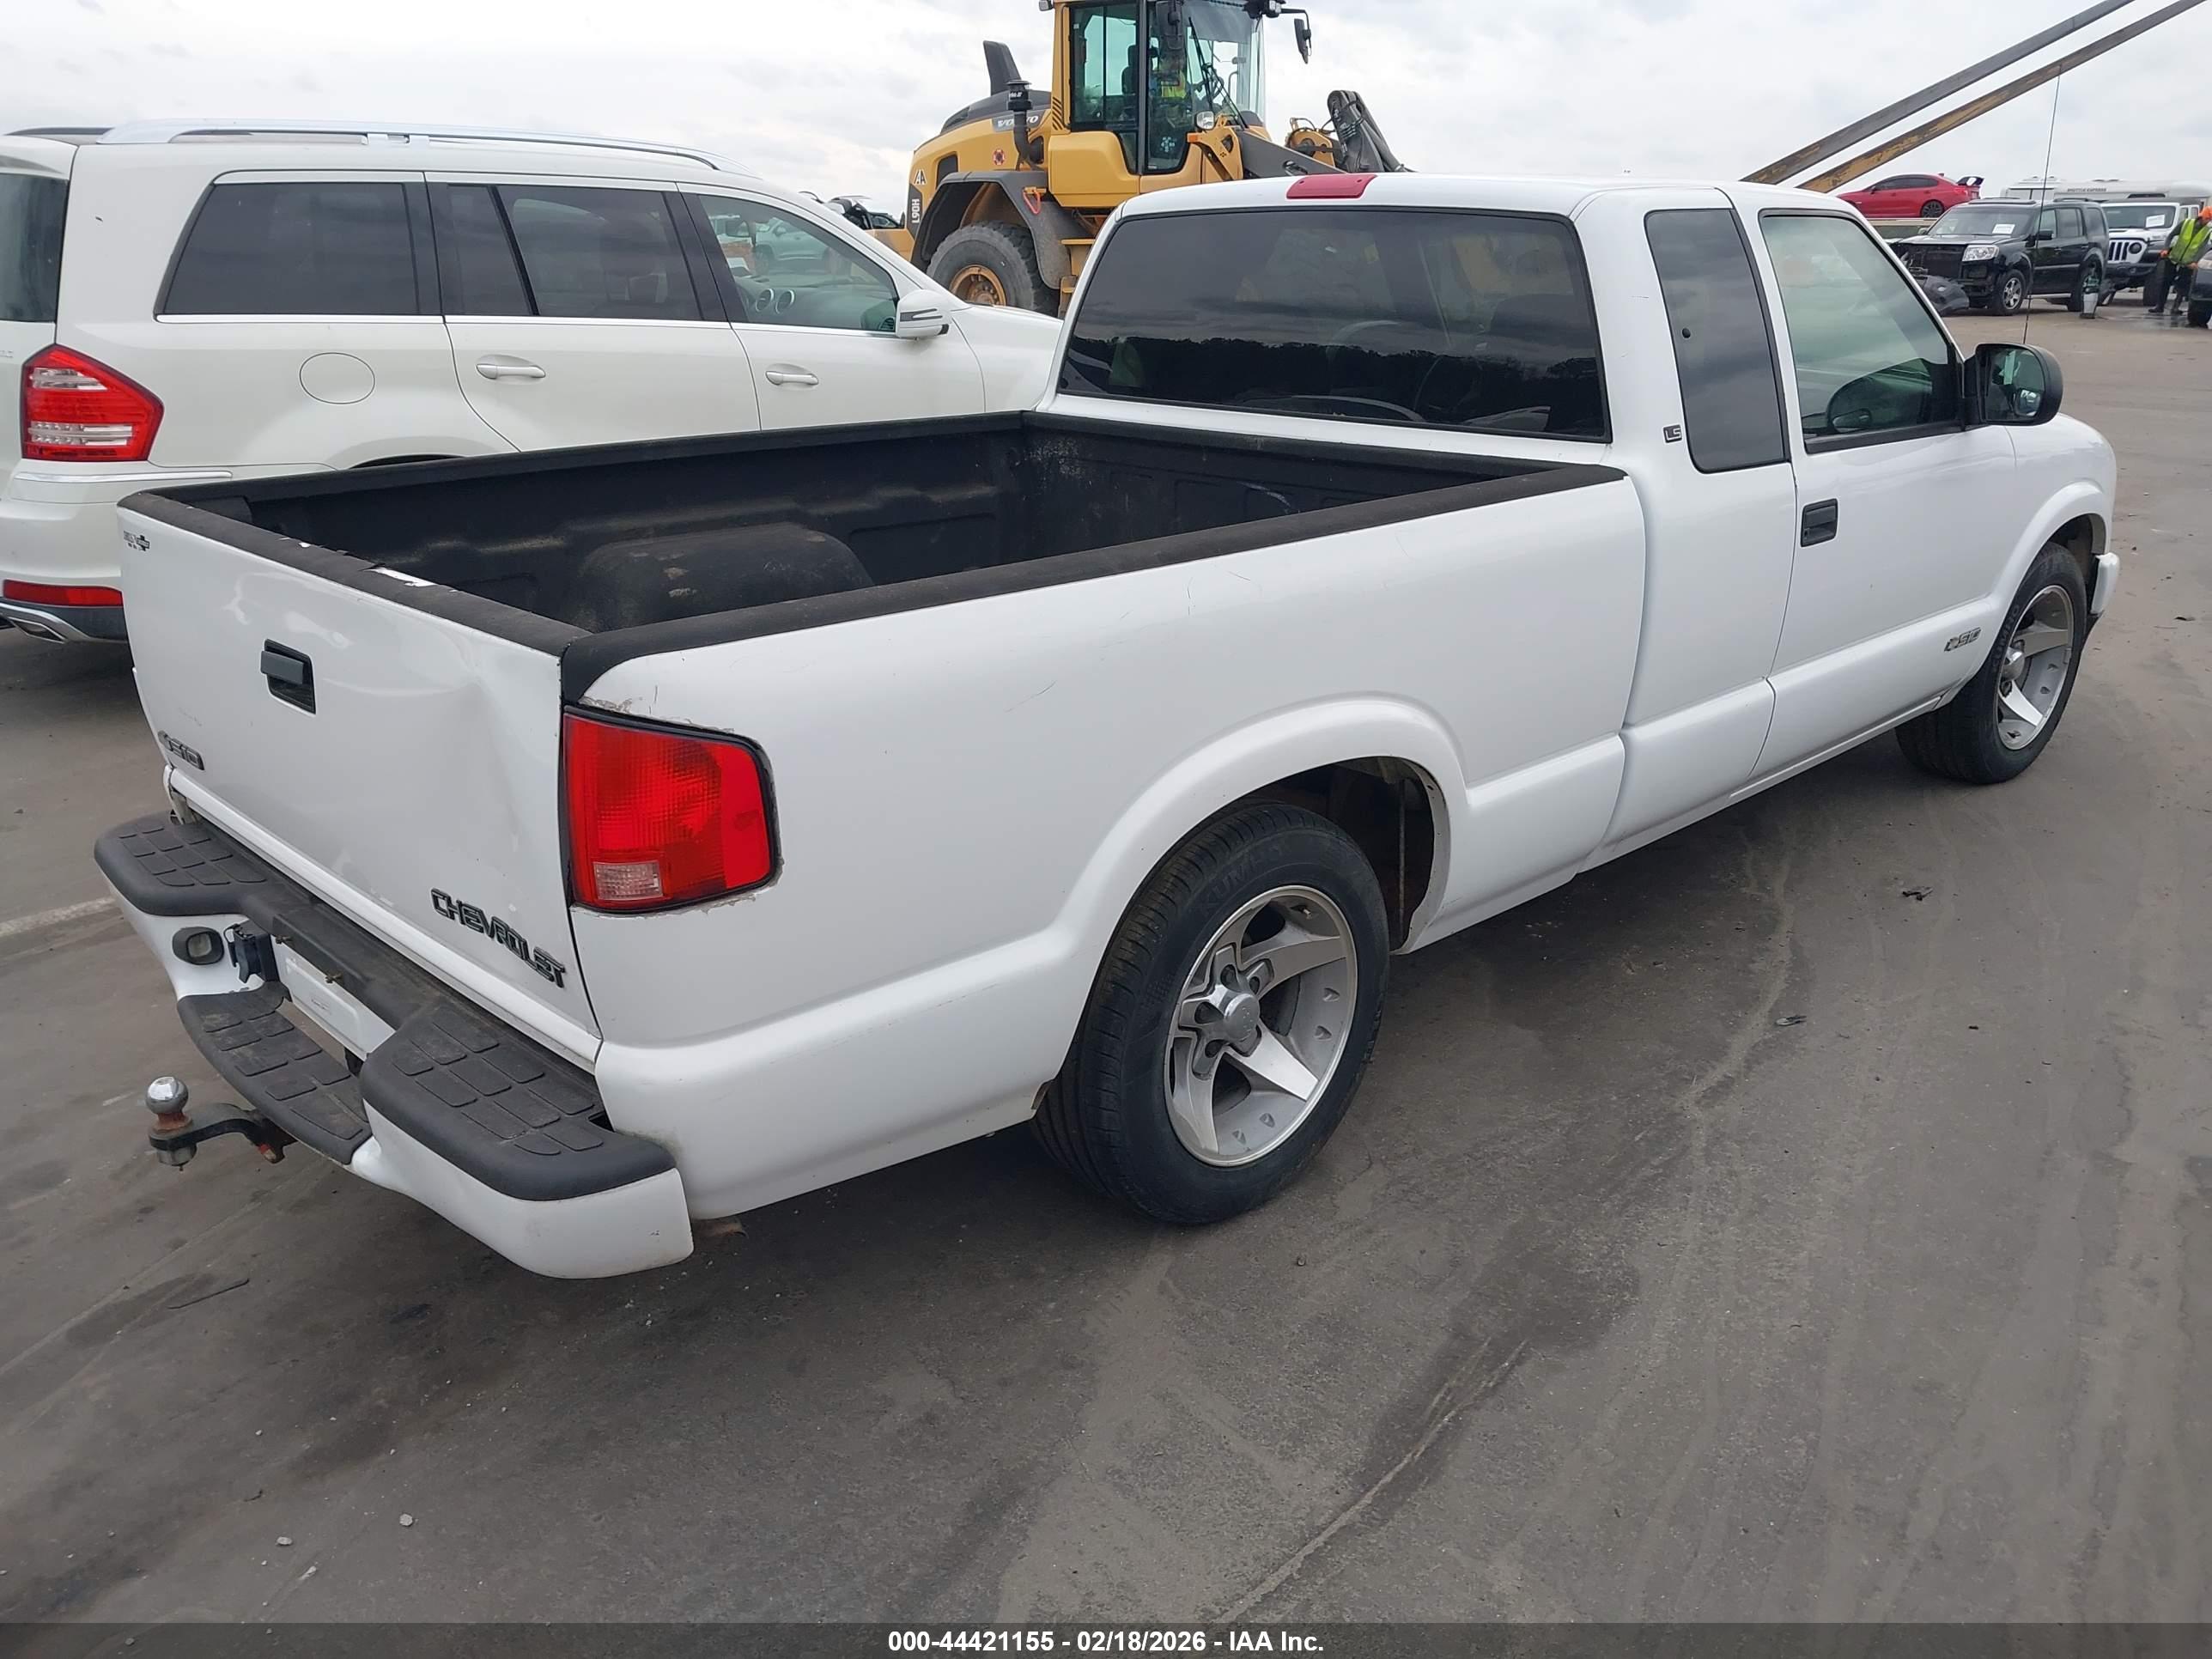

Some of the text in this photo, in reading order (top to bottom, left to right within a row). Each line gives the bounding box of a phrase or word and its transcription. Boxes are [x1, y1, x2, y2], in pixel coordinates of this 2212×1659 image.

[997, 116, 1039, 127] VOO
[911, 198, 921, 223] L90H
[1664, 427, 1682, 441] LS
[430, 887, 566, 988] CHEVROLET
